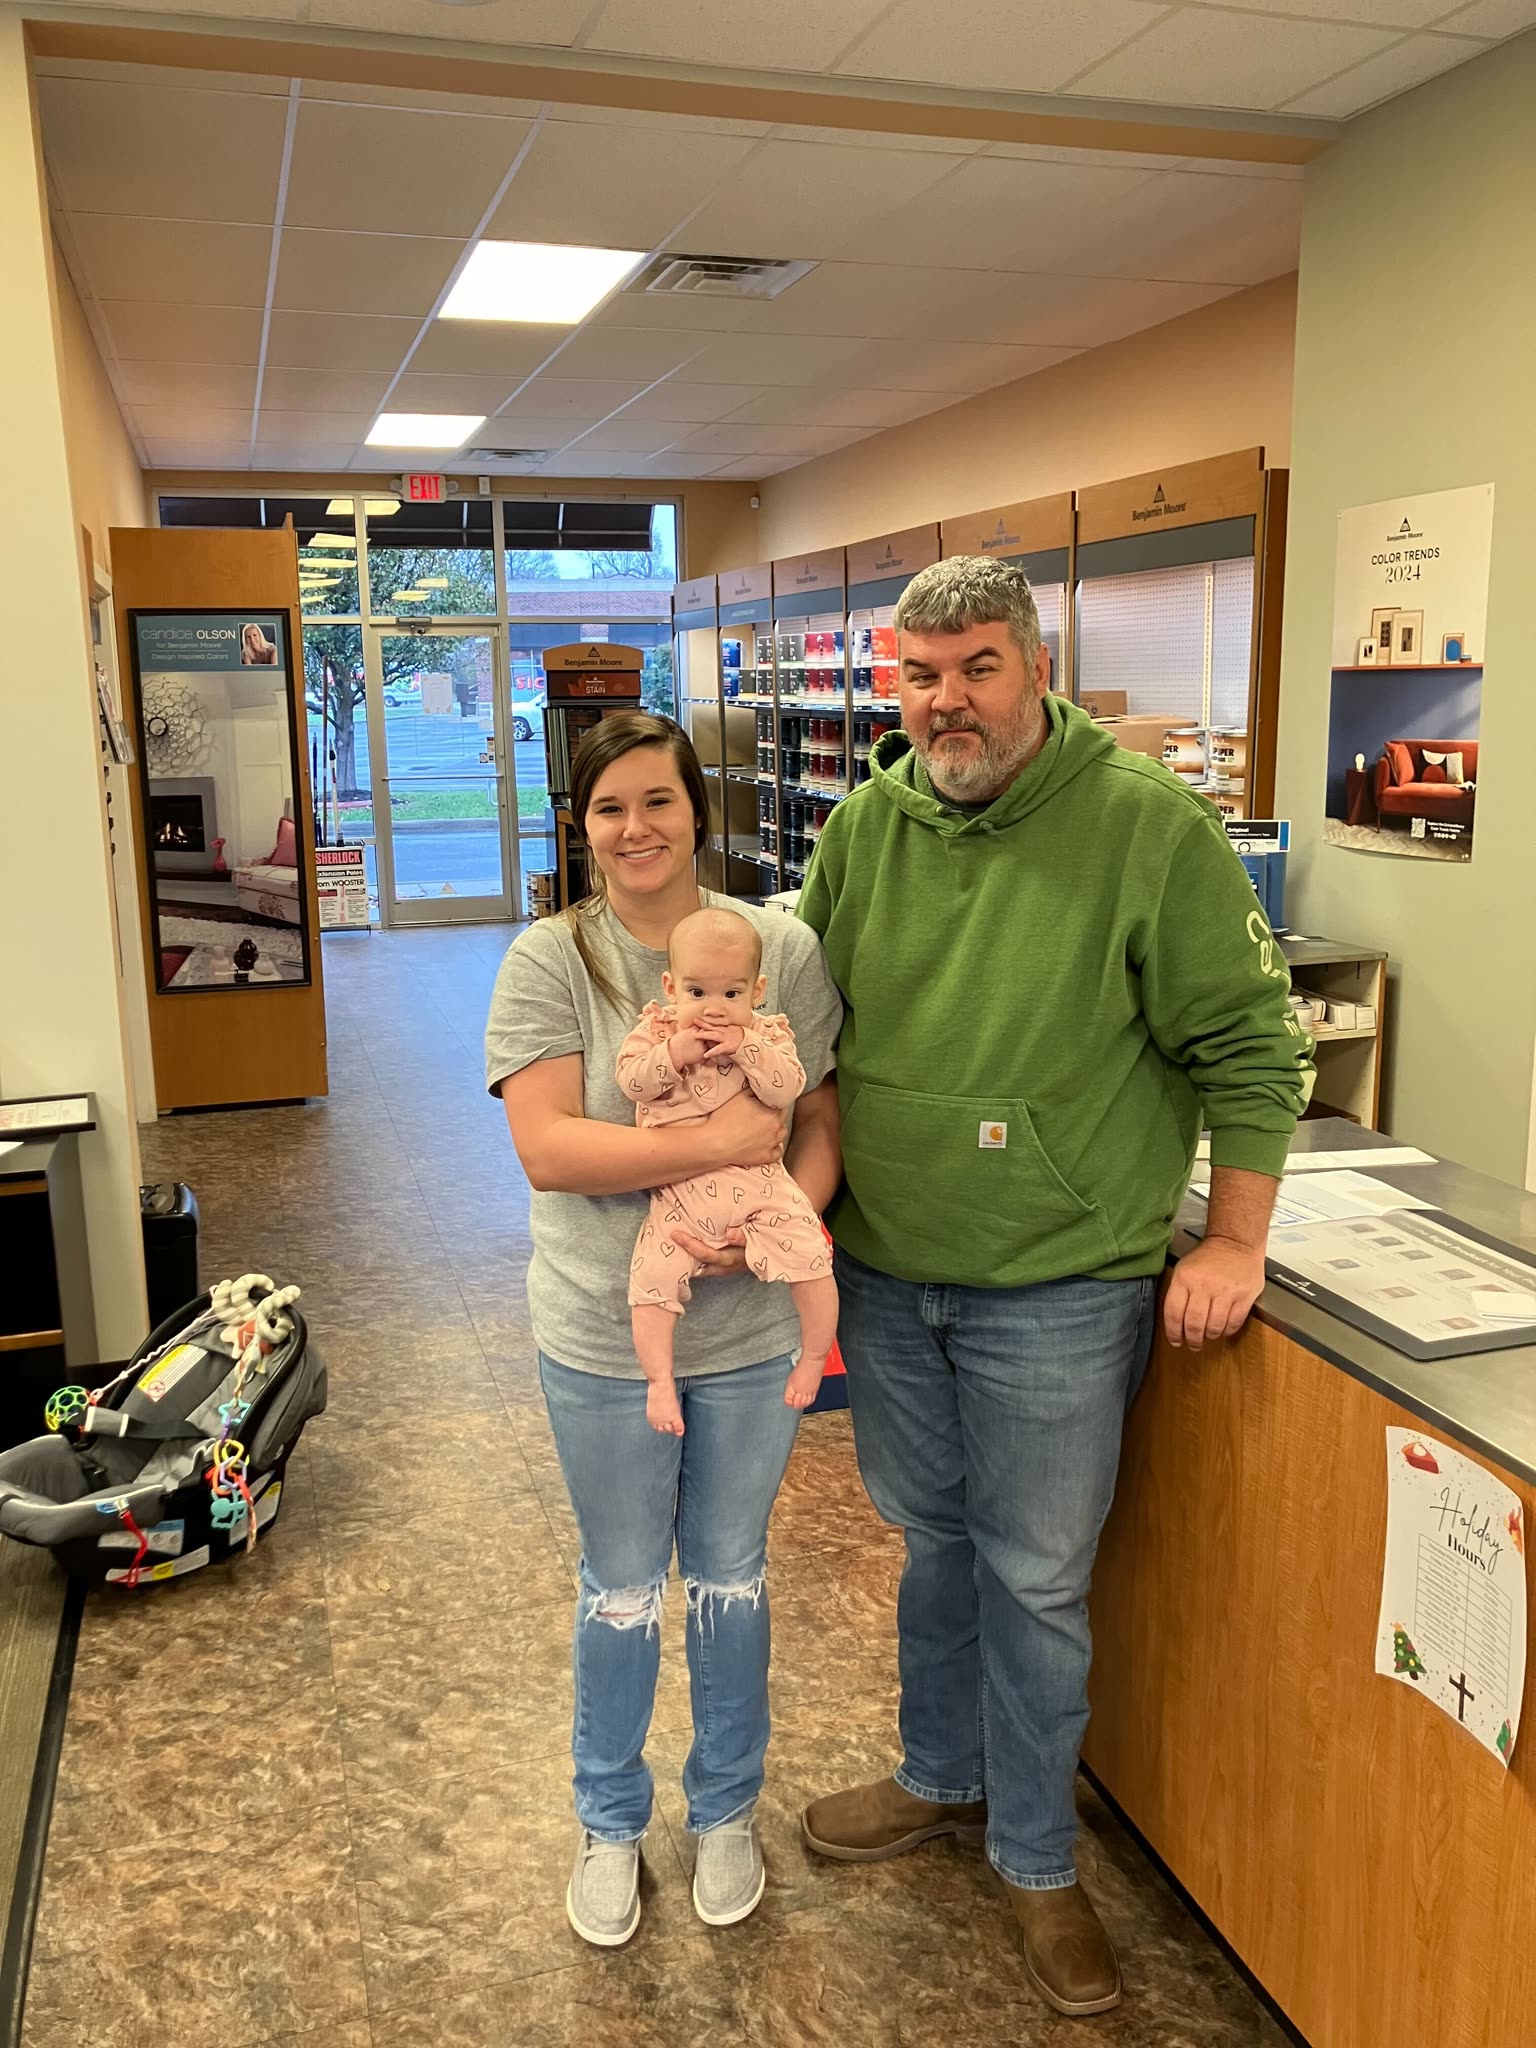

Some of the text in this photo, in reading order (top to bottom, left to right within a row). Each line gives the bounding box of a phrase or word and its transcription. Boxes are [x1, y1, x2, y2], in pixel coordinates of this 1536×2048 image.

[410, 475, 440, 500] EXIT
[1132, 502, 1187, 521] Benjamin Moore
[1371, 547, 1440, 565] COLOR TRENDS
[1385, 564, 1421, 583] 2024
[141, 627, 236, 640] candice OLSON
[167, 642, 199, 650] Benjamin
[151, 653, 176, 661] Design
[564, 658, 624, 668] Benjamin Moore
[585, 686, 606, 694] STAIN
[1162, 745, 1179, 753] PER
[1217, 748, 1235, 757] PER
[315, 851, 360, 864] SHERLOCK
[346, 869, 363, 877] Poles
[332, 879, 364, 887] WOOSTER
[1429, 1486, 1504, 1576] Holiday
[1447, 1532, 1487, 1571] Hours
